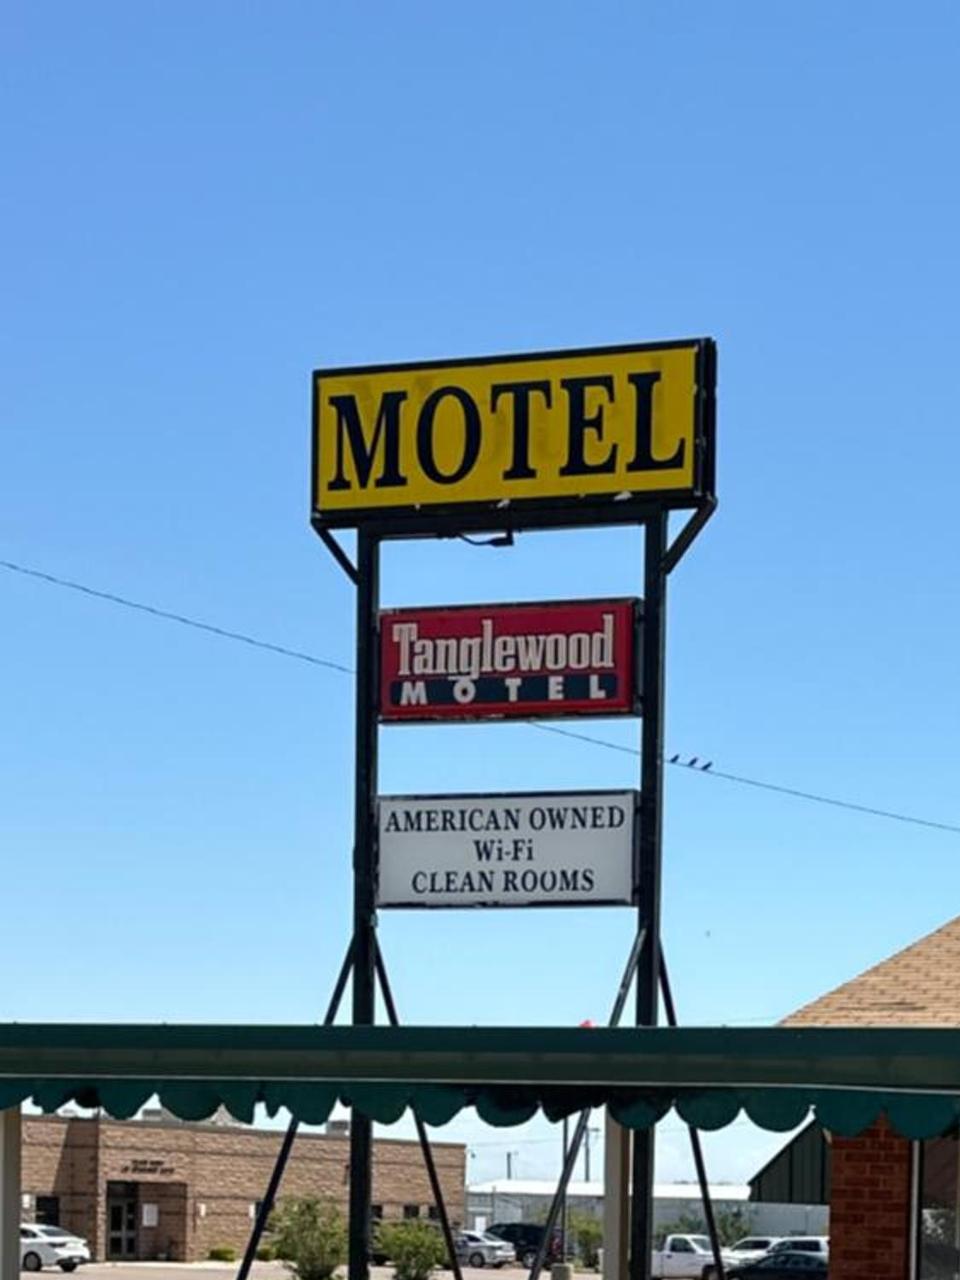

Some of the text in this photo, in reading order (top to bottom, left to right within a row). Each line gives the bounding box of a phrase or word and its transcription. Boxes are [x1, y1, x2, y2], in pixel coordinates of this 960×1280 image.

[327, 371, 686, 491] MOTEL
[392, 613, 615, 681] Tanglewood
[399, 674, 607, 706] MOTEL
[384, 806, 626, 833] AMERICAN OWNED
[472, 838, 535, 862] Wi-Fi
[411, 868, 595, 894] CLEAN ROOMS
